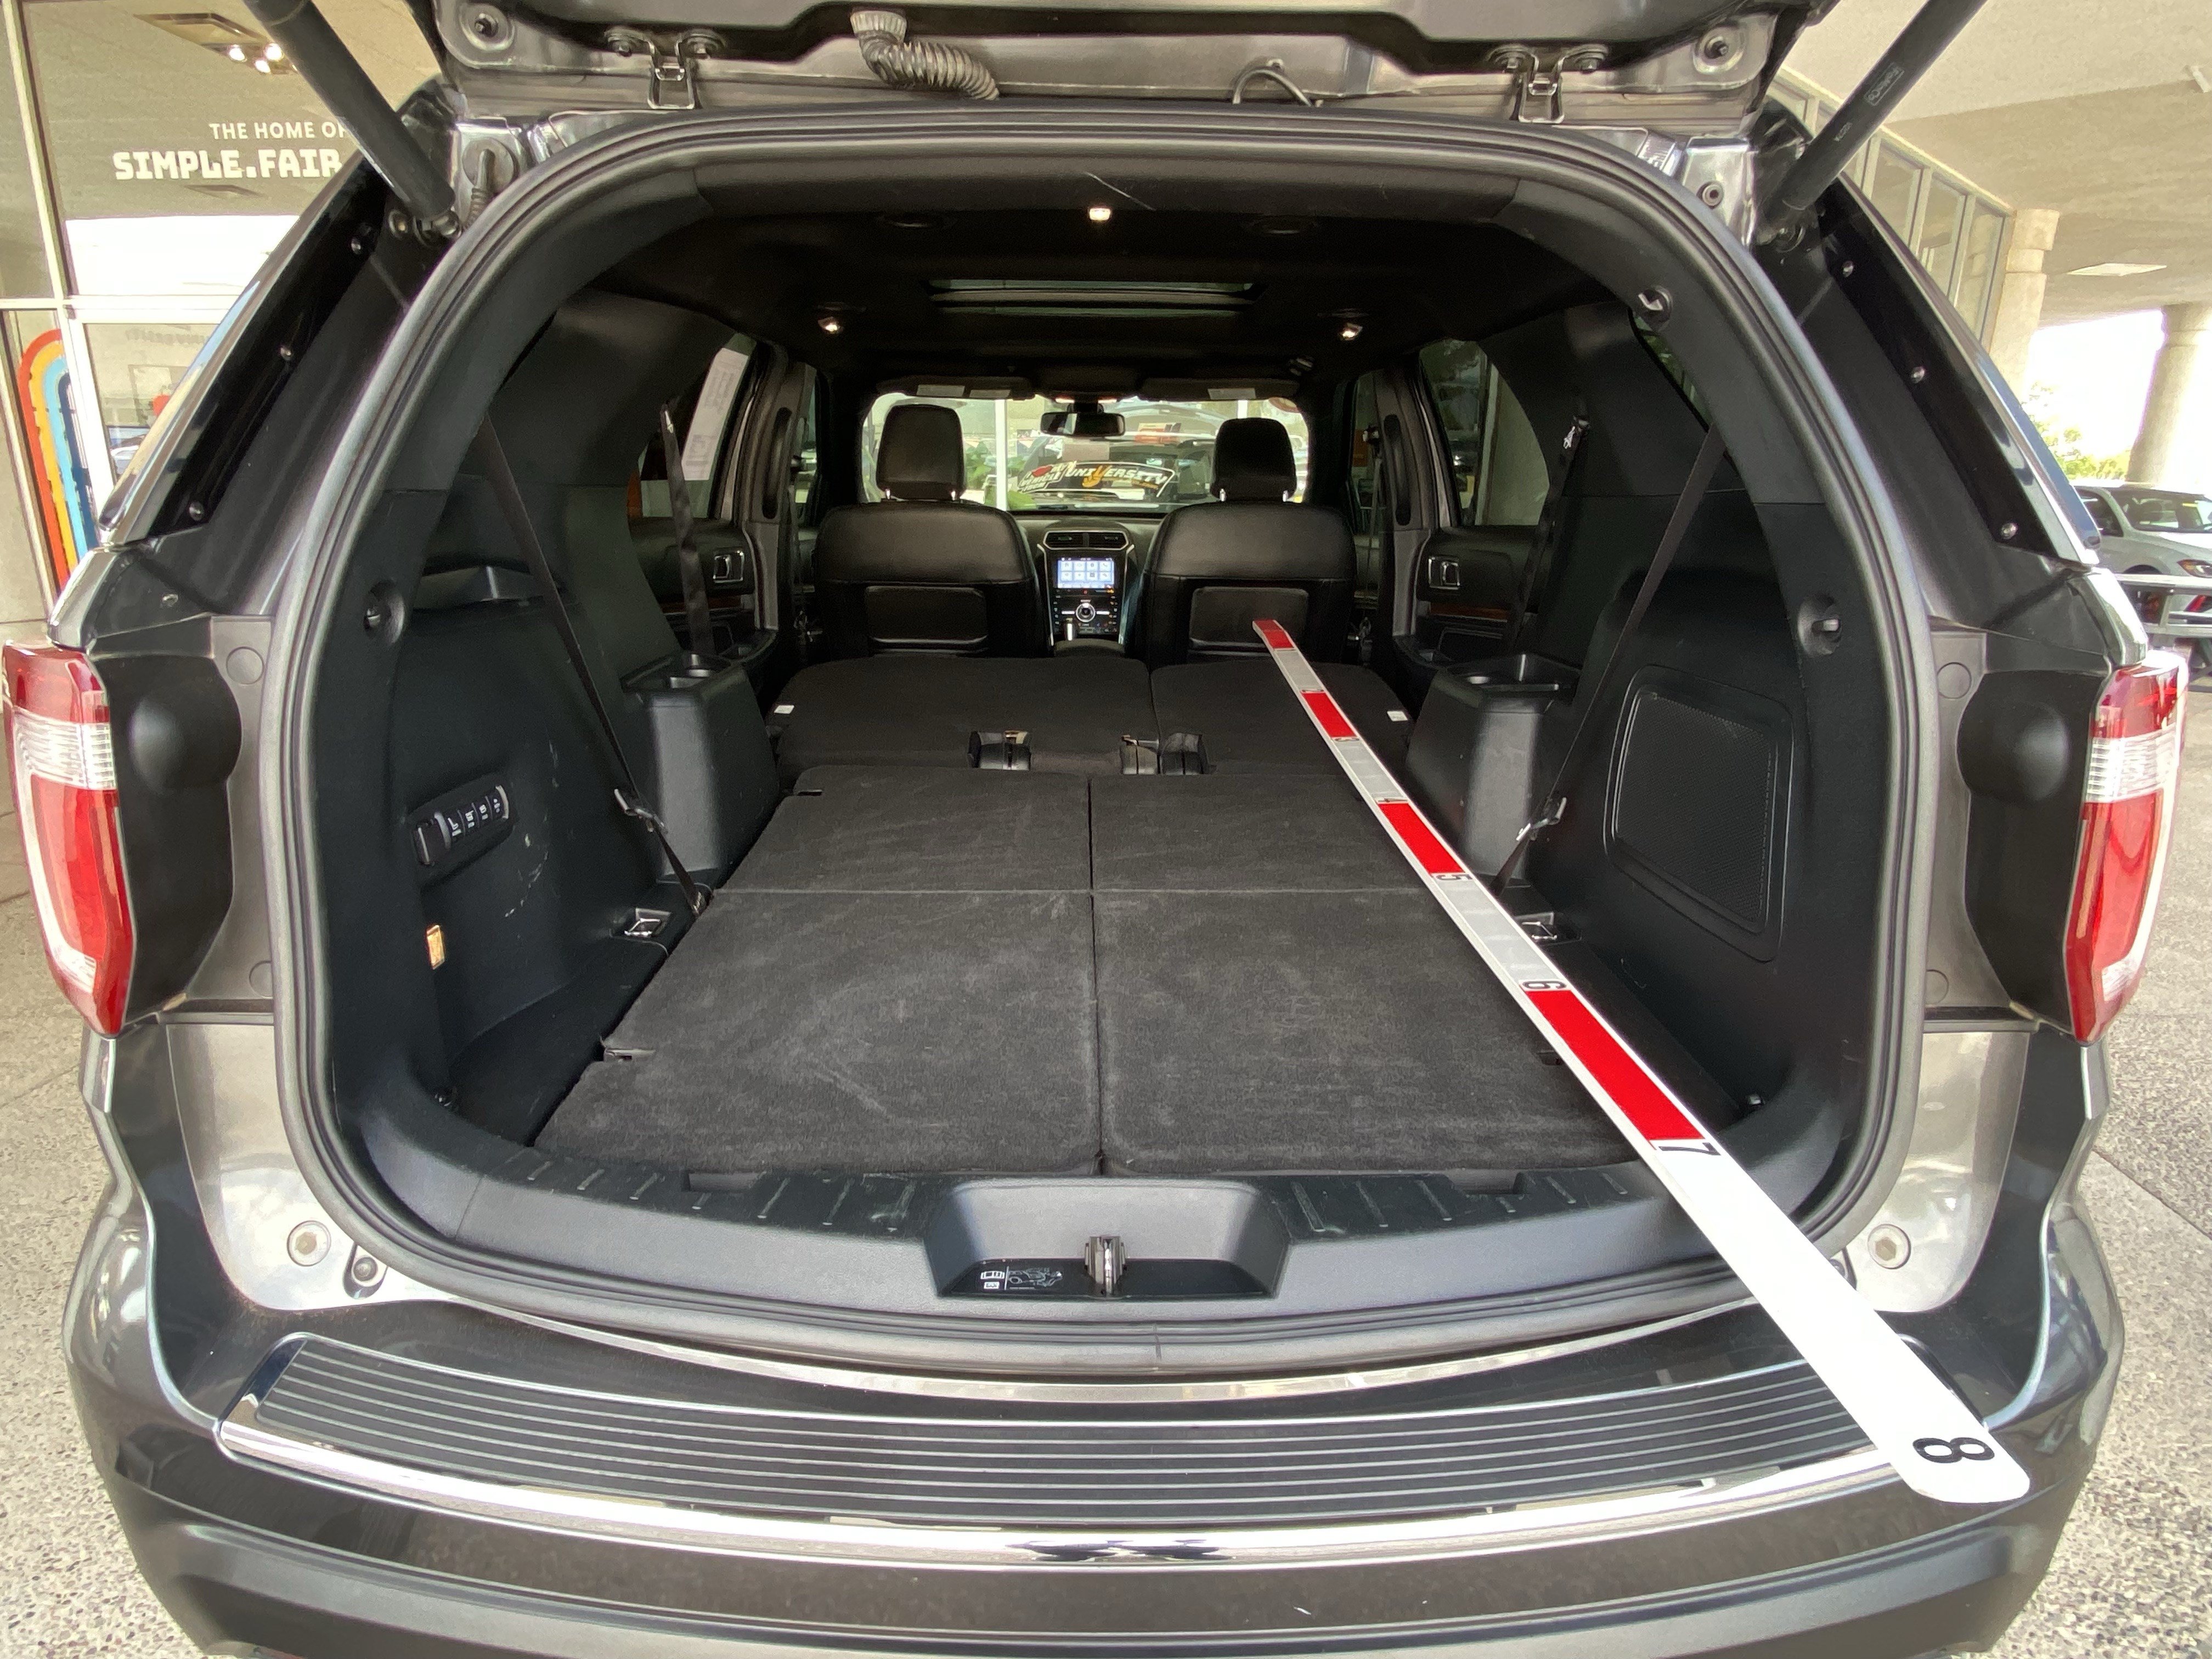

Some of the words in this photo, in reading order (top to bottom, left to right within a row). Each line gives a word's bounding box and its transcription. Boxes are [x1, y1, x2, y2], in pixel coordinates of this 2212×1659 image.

[209, 122, 248, 139] THE
[254, 121, 315, 139] HOME
[1065, 465, 1168, 487] UNIVERSITY
[1522, 980, 1567, 989] 6
[1658, 1142, 1721, 1155] 7
[1912, 1437, 1995, 1463] 8
